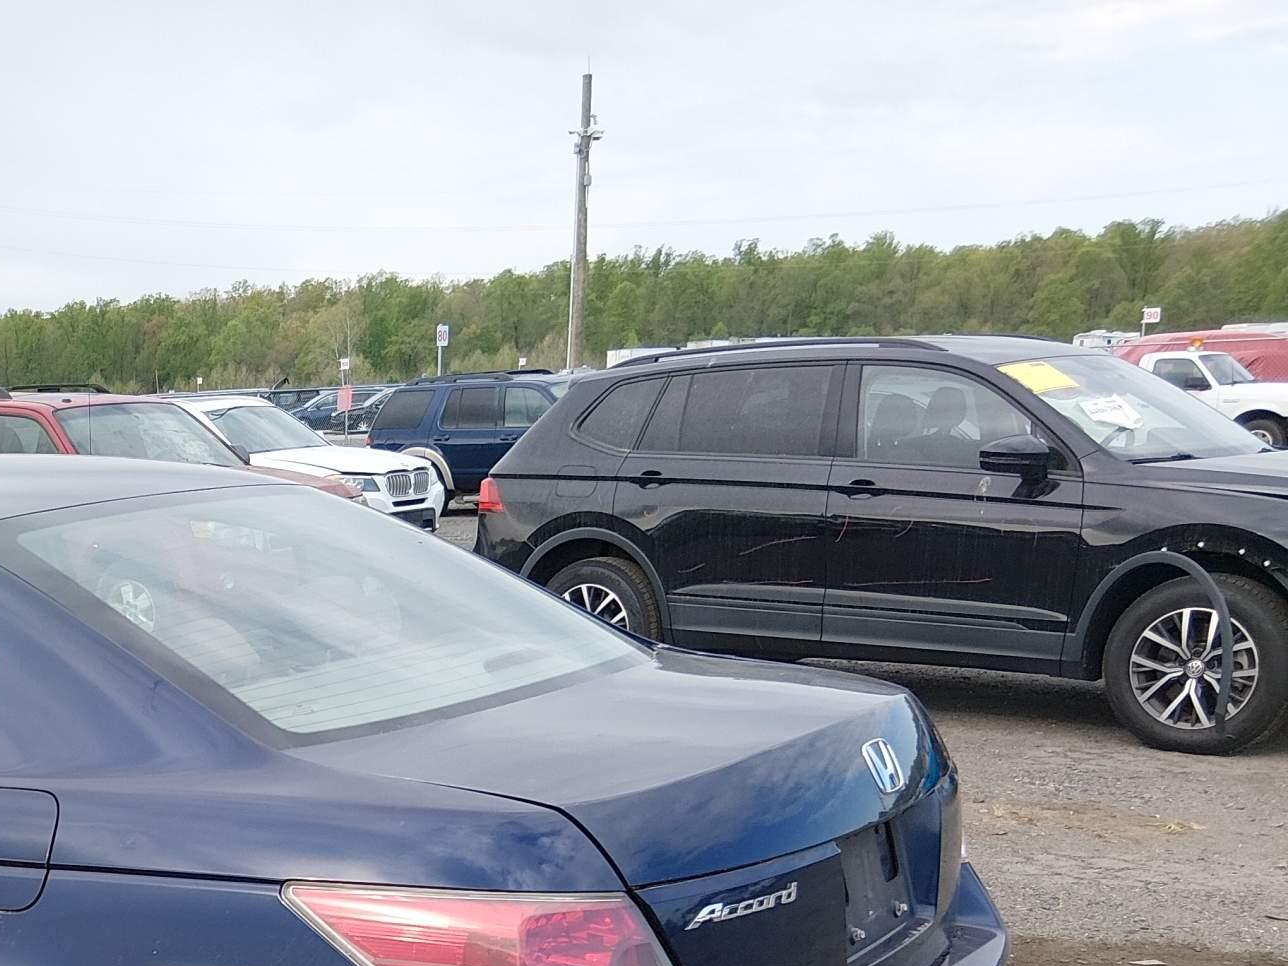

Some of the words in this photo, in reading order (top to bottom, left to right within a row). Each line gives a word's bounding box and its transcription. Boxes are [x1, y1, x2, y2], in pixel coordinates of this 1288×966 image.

[1145, 311, 1158, 320] 90
[437, 330, 447, 341] 80
[683, 881, 798, 931] Accord
